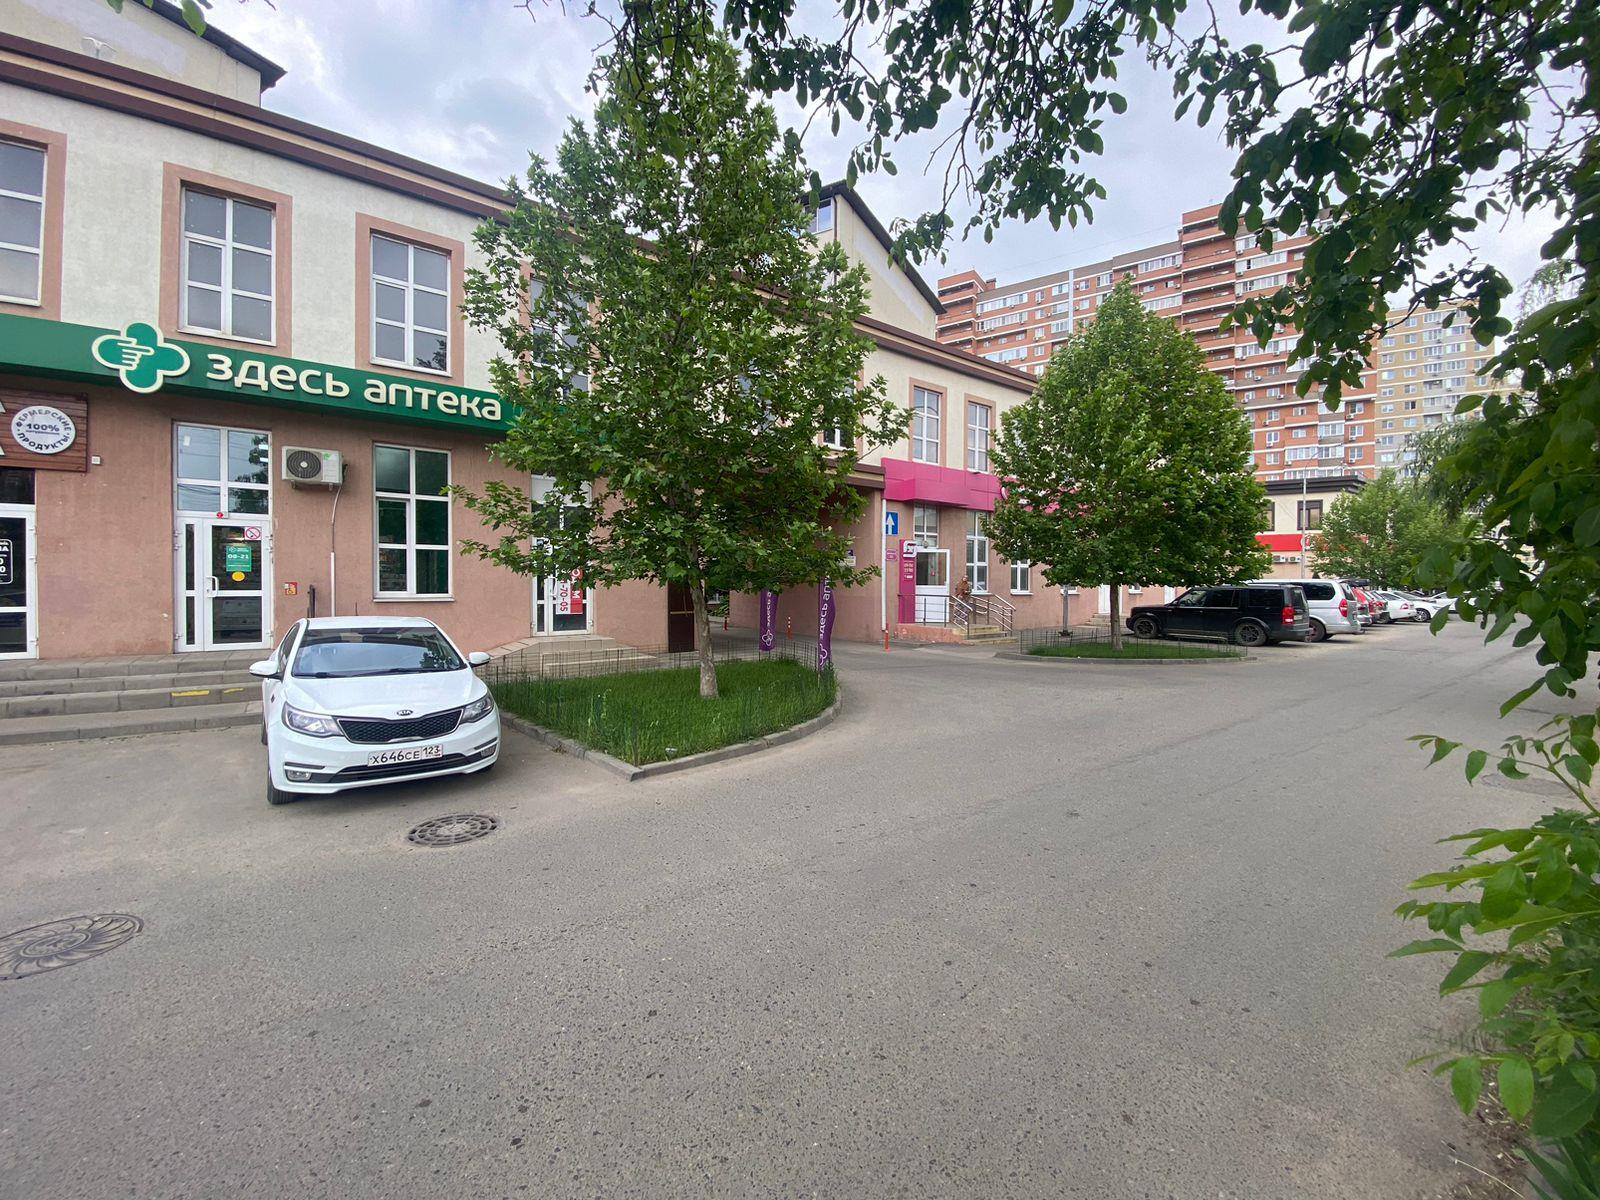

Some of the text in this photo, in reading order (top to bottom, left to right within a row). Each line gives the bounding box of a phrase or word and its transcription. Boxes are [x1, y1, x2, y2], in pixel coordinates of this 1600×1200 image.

[206, 353, 502, 421] здесь аптека
[16, 408, 72, 431] ФЕРМЕРСКИЕ
[26, 423, 60, 431] 100%
[17, 432, 71, 451] ПРОДУКТЫ
[372, 750, 420, 765] Х646СЕ
[423, 745, 440, 755] 123
